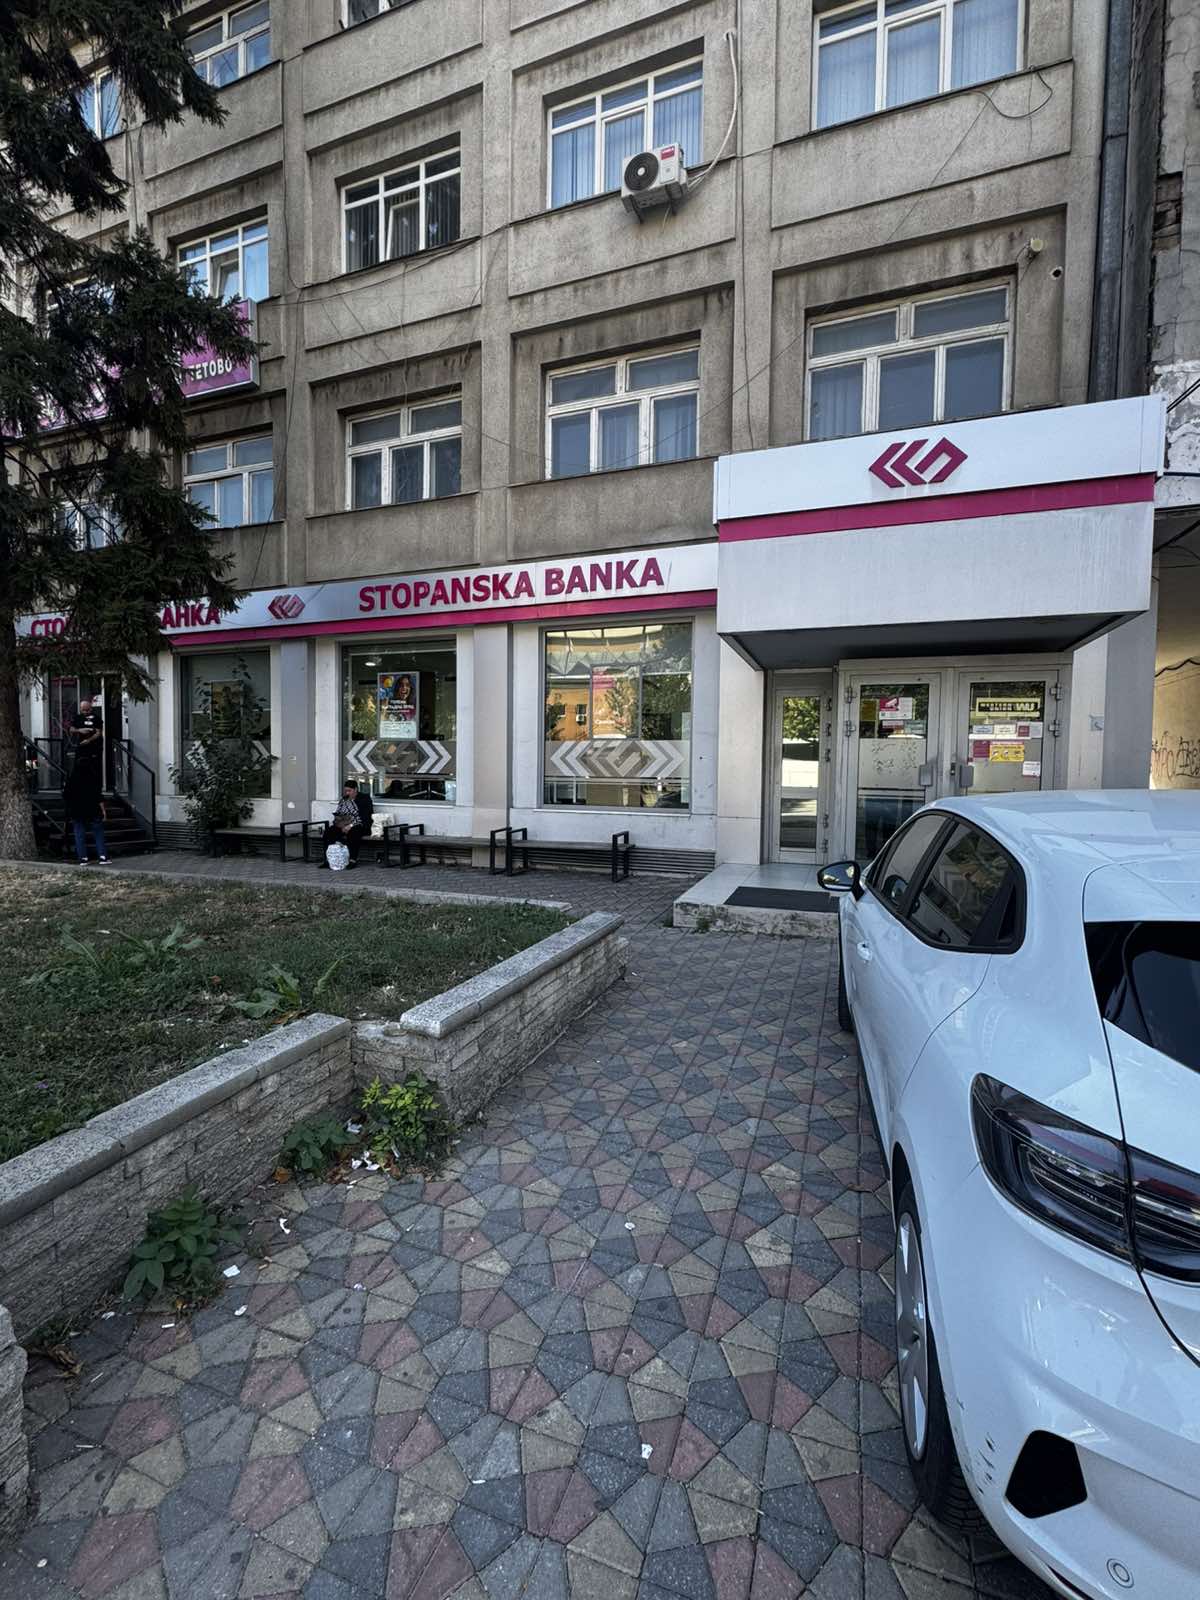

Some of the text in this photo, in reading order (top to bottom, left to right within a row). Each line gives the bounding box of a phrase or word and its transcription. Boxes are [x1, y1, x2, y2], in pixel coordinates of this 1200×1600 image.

[359, 557, 665, 612] STOPANSKA BANKA
[160, 603, 221, 629] АНКА
